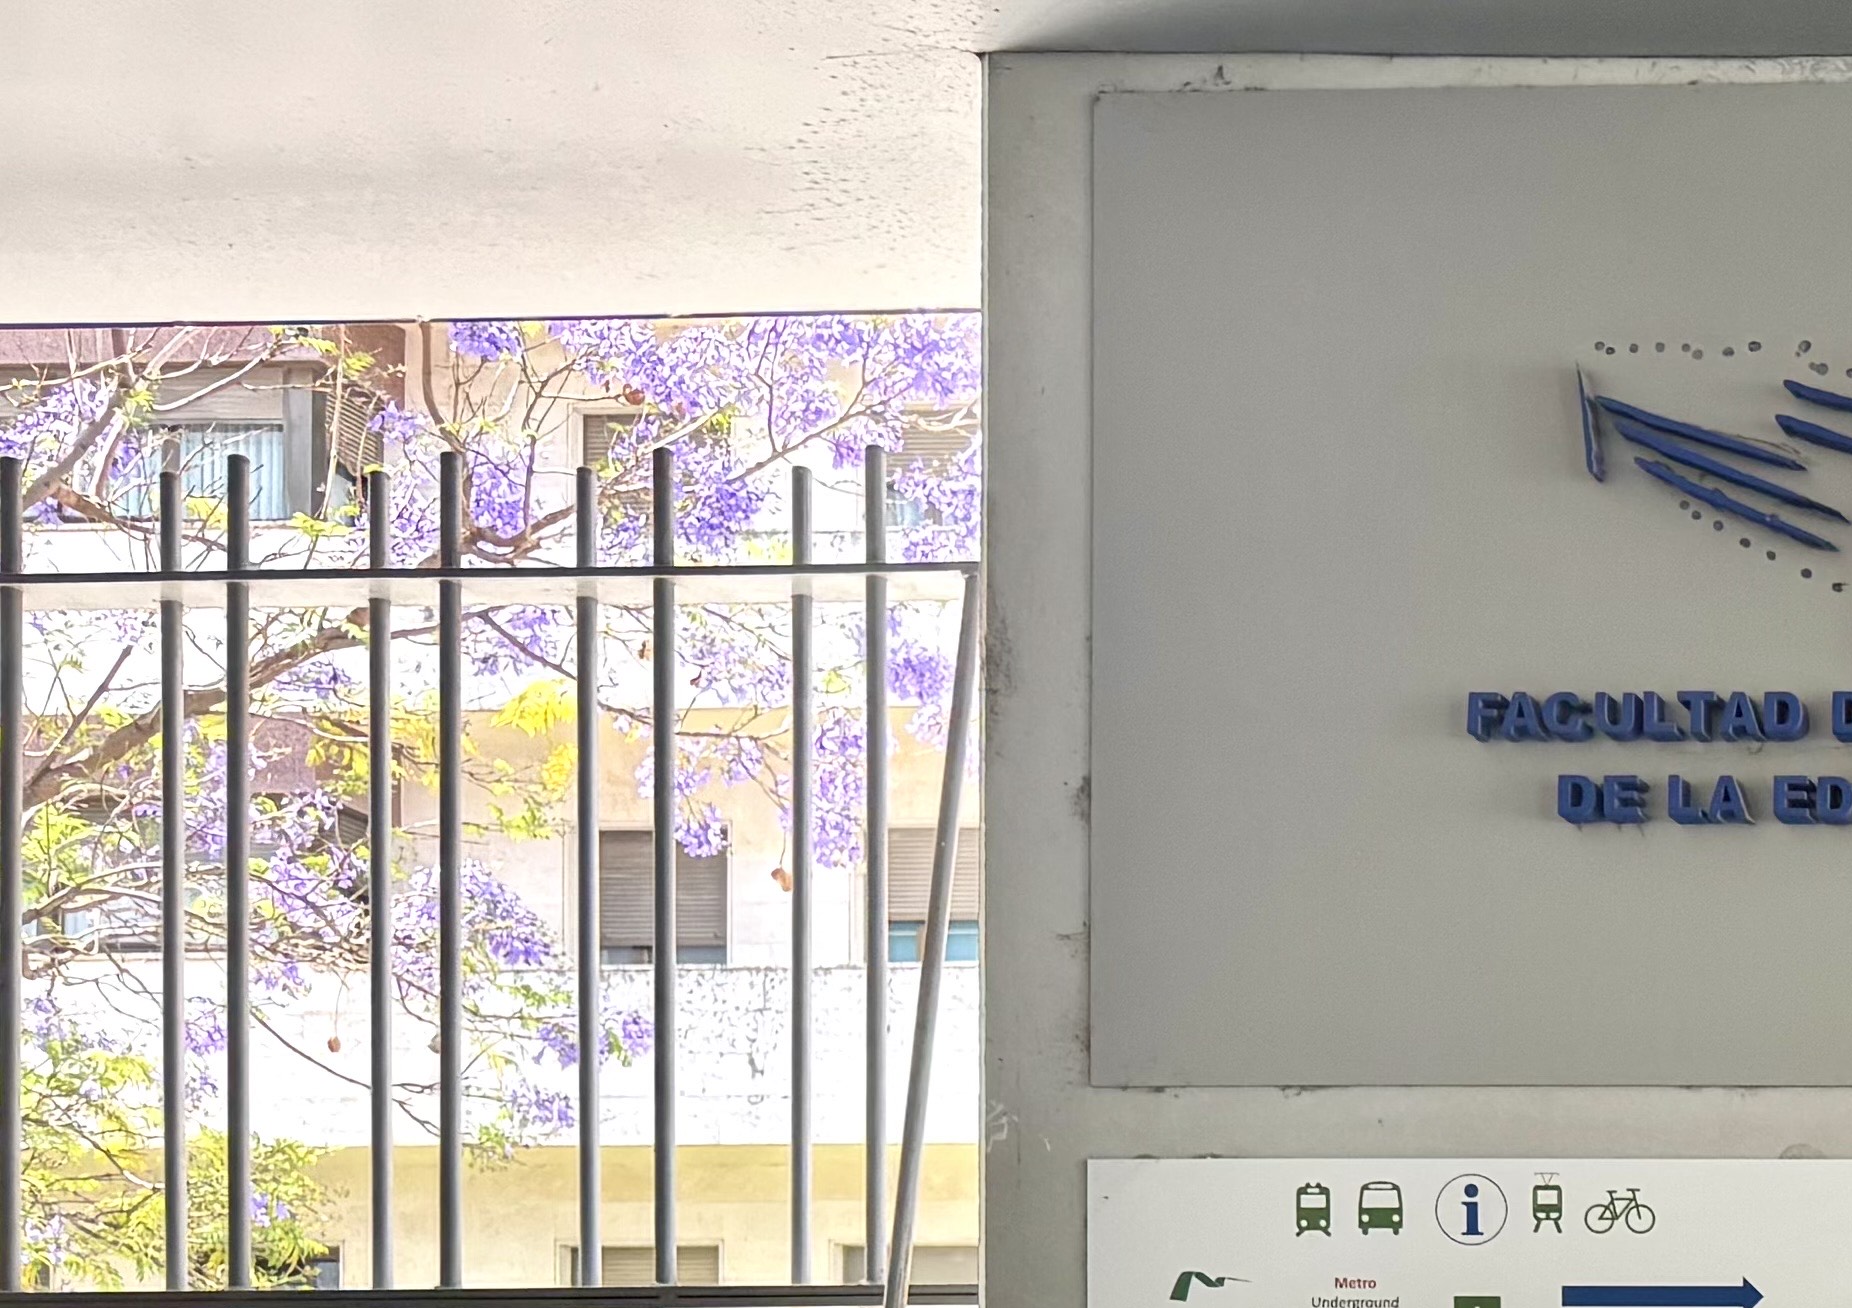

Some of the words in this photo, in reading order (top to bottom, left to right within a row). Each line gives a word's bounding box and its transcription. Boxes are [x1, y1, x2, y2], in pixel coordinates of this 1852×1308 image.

[1467, 691, 1808, 743] FACULTAD
[1557, 774, 1649, 824] DE
[1668, 774, 1756, 825] LA
[1334, 1277, 1377, 1290] Metro
